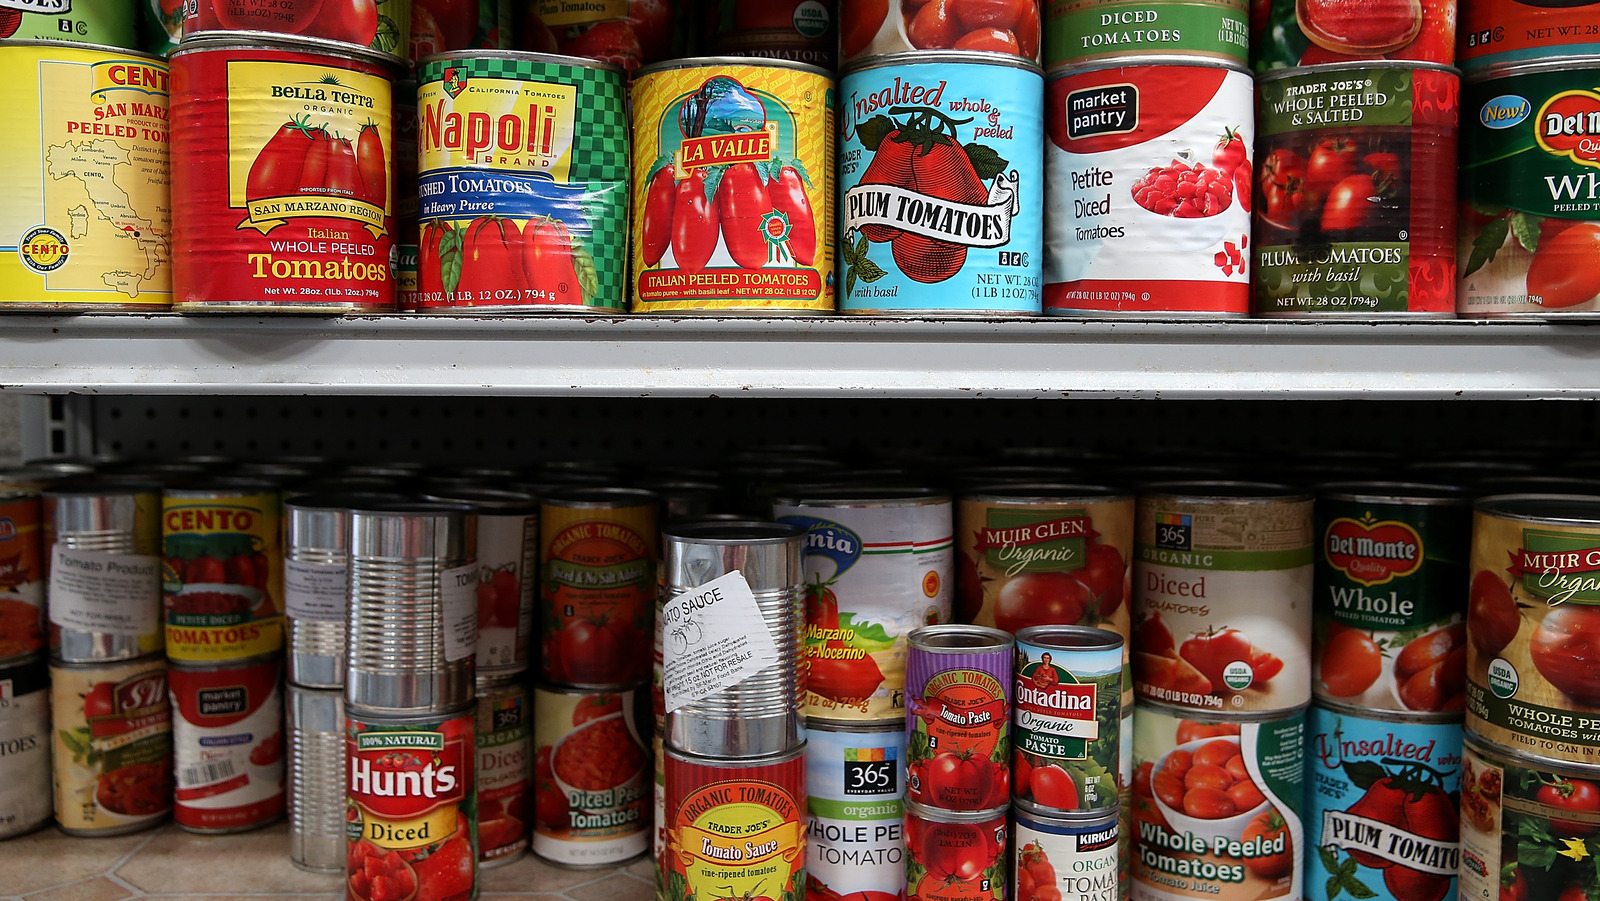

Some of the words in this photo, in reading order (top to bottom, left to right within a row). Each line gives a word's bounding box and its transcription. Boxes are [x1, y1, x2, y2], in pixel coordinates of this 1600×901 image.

[561, 2, 606, 12] Tomatoes
[801, 8, 823, 18] USDA
[274, 12, 295, 22] 794g
[1101, 10, 1158, 26] DICED
[1081, 29, 1181, 48] TOMATOES
[1526, 27, 1554, 40] NET
[1557, 25, 1582, 36] WT.
[1585, 25, 1599, 35] 28
[108, 65, 169, 92] CENT
[469, 86, 520, 95] CALIFORNIA
[524, 89, 566, 100] TOMATOES
[1286, 80, 1327, 96] TRADER
[303, 104, 354, 115] ORGANIC
[841, 77, 947, 141] Unsalted
[949, 98, 990, 113] whole
[1073, 90, 1127, 111] market
[1274, 97, 1324, 114] WHOLE
[1330, 93, 1388, 108] PEELED
[94, 103, 127, 121] SAN
[1073, 109, 1126, 130] pantry
[1291, 114, 1303, 126] &
[1306, 108, 1364, 124] SALTED
[1485, 101, 1526, 122] New!
[67, 121, 137, 138] PEELED
[974, 126, 1013, 140] peeled
[1546, 111, 1585, 137] Del
[682, 144, 705, 163] LA
[710, 137, 770, 158] VALLE
[840, 149, 861, 165] TRADER
[485, 156, 549, 167] BRAND
[449, 175, 533, 194] TOMATOES
[1071, 167, 1113, 190] Petite
[254, 204, 281, 216] SAN
[284, 202, 347, 213] MARZANO
[350, 206, 382, 222] REGION
[430, 202, 456, 214] Heavy
[460, 199, 494, 211] Puree
[1074, 193, 1110, 219] Diced
[1554, 203, 1590, 212] PEELED
[850, 191, 891, 219] PLUM
[896, 195, 1003, 240] TOMATOES
[307, 227, 349, 240] Italian
[1075, 225, 1125, 241] Tomatoes
[22, 245, 69, 254] CENTO
[270, 241, 327, 253] WHOLE
[331, 243, 375, 256] PEELED
[248, 253, 386, 282] Tomatoes
[1292, 267, 1321, 283] with
[1326, 267, 1360, 282] basil
[648, 274, 686, 288] ITALIAN
[689, 273, 739, 285] PEELED
[742, 274, 809, 286] TOMATOES
[977, 274, 1000, 285] NET
[1004, 274, 1022, 286] WT.
[1023, 276, 1032, 286] 28
[458, 291, 475, 301] LB.
[479, 291, 491, 300] 12
[524, 289, 546, 299] 794
[854, 286, 872, 298] with
[874, 286, 898, 298] basil
[984, 288, 997, 298] LB
[1001, 288, 1010, 298] 12
[1277, 297, 1295, 307] NET
[1297, 297, 1315, 306] WT.
[1316, 297, 1328, 305] 28
[1331, 297, 1347, 305] OZ
[1349, 297, 1379, 307] (794g)
[166, 509, 253, 531] CENTO
[551, 525, 591, 556] ORGANIC
[986, 528, 1031, 544] MUIR
[1035, 520, 1085, 538] GLEN
[1159, 527, 1185, 545] 365
[1329, 534, 1354, 555] Del
[1356, 537, 1417, 559] Monte
[58, 553, 103, 572] Tomato
[998, 540, 1075, 578] Organic
[1143, 548, 1213, 566] ORGANIC
[1524, 553, 1580, 569] MUIR
[1350, 559, 1387, 575] Quality
[1147, 572, 1206, 598] Diced
[681, 587, 724, 615] SAUCE
[1145, 598, 1210, 617] TOMATOES
[1329, 586, 1414, 616] Whole
[1334, 610, 1359, 620] PEELED
[1361, 614, 1405, 625] TOMATOES
[167, 627, 260, 645] TOMATOES
[806, 624, 854, 641] Marzano
[701, 668, 714, 679] NOT
[714, 662, 727, 673] FOR
[727, 650, 753, 667] RESALE
[1492, 665, 1511, 680] USDA
[927, 672, 958, 696] ORGANIC
[962, 672, 1002, 698] TOMATOES
[1490, 677, 1514, 691] ORGANIC
[202, 690, 241, 700] market
[1016, 681, 1091, 710] Contadina
[1204, 695, 1223, 707] 794g
[202, 700, 242, 713] pantry
[841, 697, 869, 713] 794g
[940, 703, 966, 725] Tomato
[968, 711, 991, 725] Paste
[1021, 711, 1074, 733] Organic
[1508, 703, 1573, 728] WHOLE
[1508, 716, 1578, 739] TOMATOES
[385, 736, 437, 746] NATURAL
[1025, 739, 1066, 756] PASTE
[1030, 733, 1059, 744] TOMATO
[1511, 733, 1536, 746] FIELD
[1540, 740, 1554, 749] TO
[1556, 743, 1579, 754] CAN
[1582, 747, 1594, 756] IN
[1313, 731, 1436, 769] Unsalted
[851, 763, 889, 788] 365
[1315, 773, 1349, 792] TRADER
[568, 790, 614, 808] Diced
[684, 788, 733, 822] ORGANIC
[739, 787, 793, 819] TOMATOES
[568, 808, 640, 829] Tomatoes
[843, 803, 897, 818] organic
[371, 822, 430, 841] Diced
[708, 822, 742, 834] TRADER
[1332, 817, 1382, 849] PLUM
[1139, 820, 1205, 853] Whole
[1214, 832, 1284, 857] Peeled
[701, 837, 742, 860] Tomato
[745, 840, 777, 859] Sauce
[1139, 843, 1243, 881] Tomatoes
[701, 868, 745, 879] vine-ripened
[747, 865, 777, 877] tomatoes
[1151, 870, 1187, 889] Tomato
[1191, 879, 1220, 894] Juice
